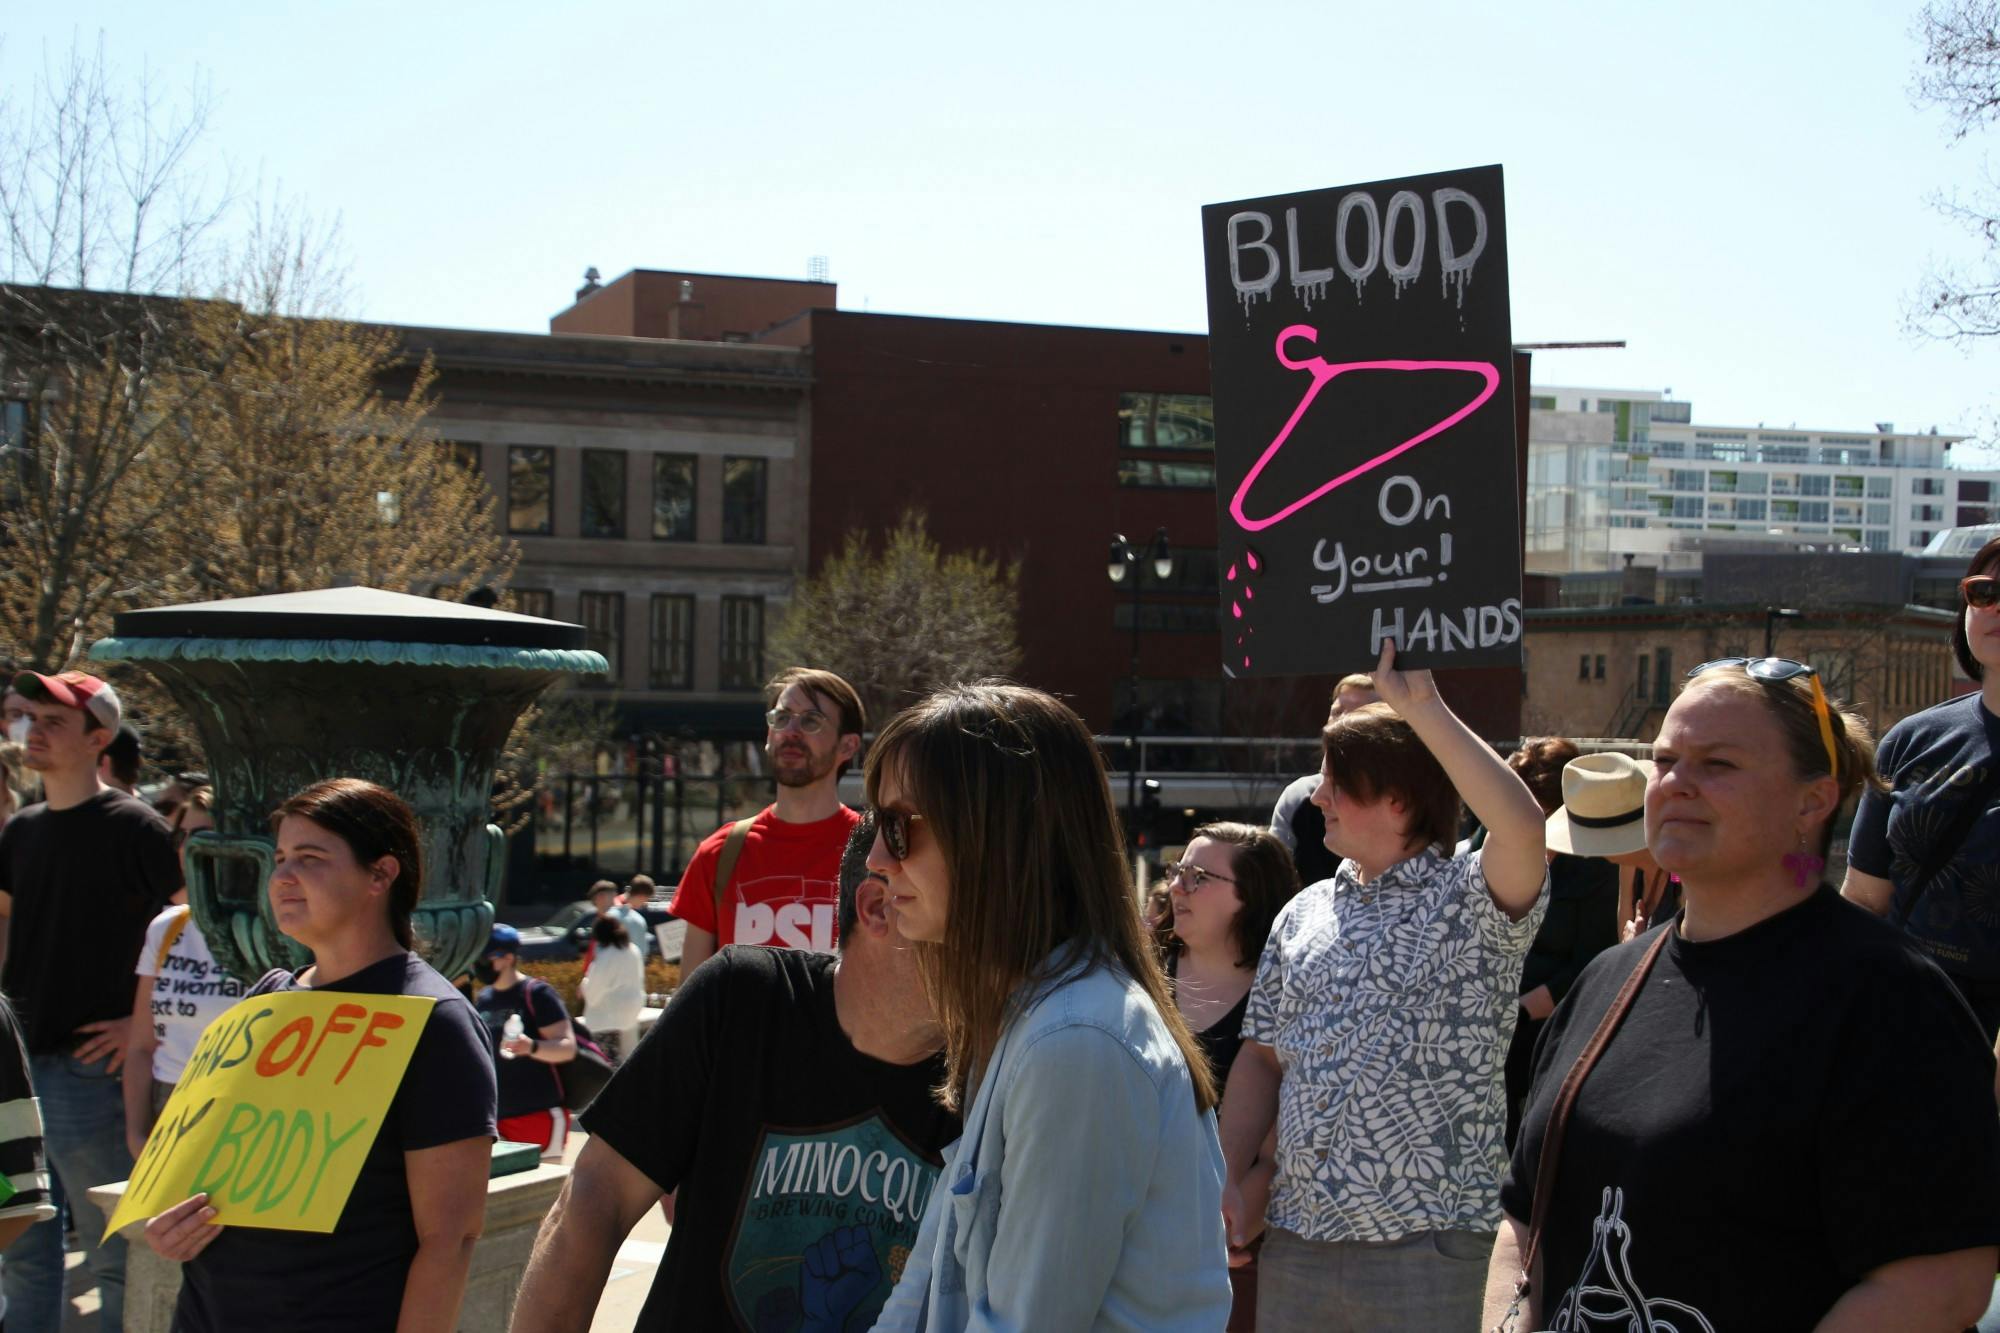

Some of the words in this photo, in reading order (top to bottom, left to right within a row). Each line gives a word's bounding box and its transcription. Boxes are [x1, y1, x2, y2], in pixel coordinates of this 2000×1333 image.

[1228, 187, 1489, 300] BLOOD
[1378, 475, 1452, 526] On
[1370, 598, 1521, 655] HANDS
[178, 998, 197, 1017] to
[255, 1003, 405, 1086] OFF
[187, 1103, 368, 1217] BODY
[753, 1141, 937, 1223] MINOCQU
[756, 1198, 849, 1221] BREWING
